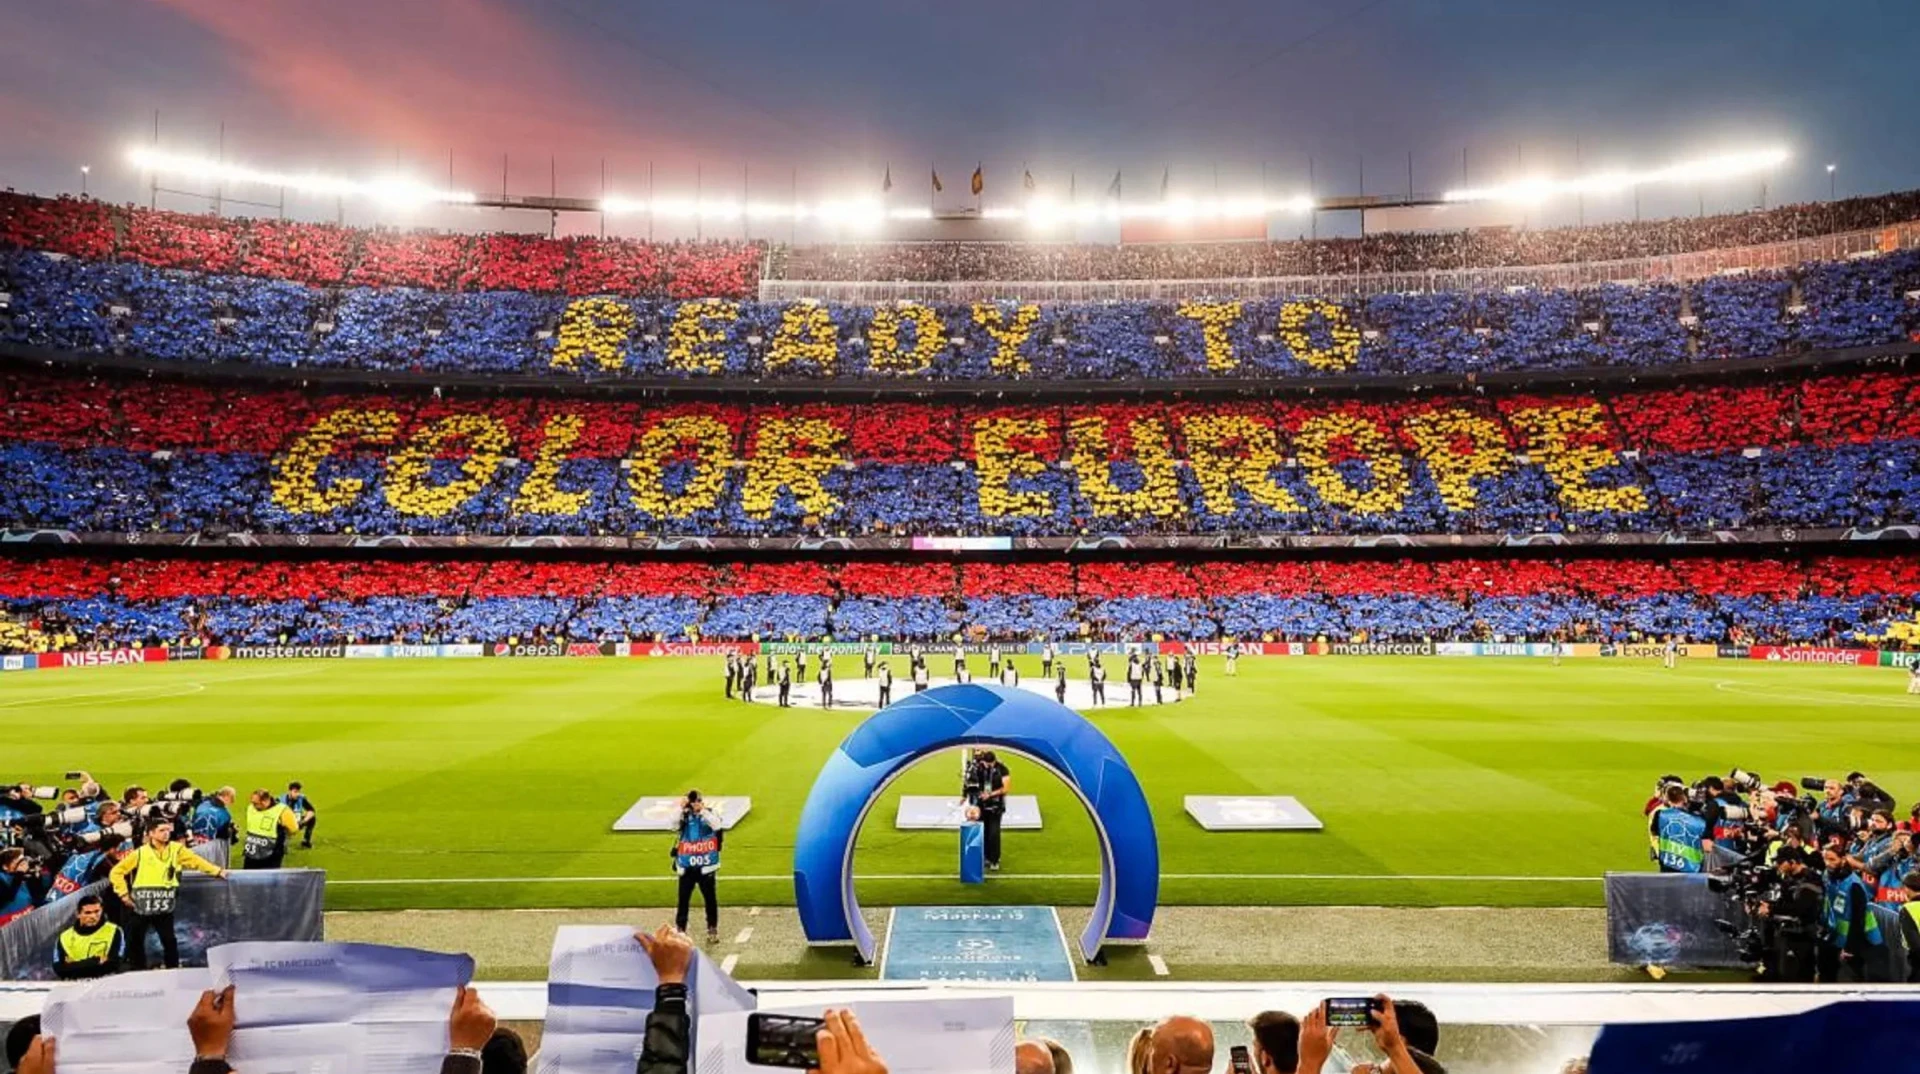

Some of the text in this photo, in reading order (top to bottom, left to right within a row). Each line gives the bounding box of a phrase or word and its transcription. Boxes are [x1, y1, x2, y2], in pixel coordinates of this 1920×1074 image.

[551, 298, 1361, 374] READY TO
[270, 404, 1648, 519] COLOR EUROPE
[236, 645, 341, 658] mastercard
[515, 644, 562, 656] pepsi
[1333, 643, 1431, 655] mastercard
[1623, 645, 1688, 657] Expea
[1781, 646, 1862, 664] Santander
[63, 650, 145, 667] NISSAN
[683, 840, 715, 853] PHOTO
[689, 855, 711, 866] 005
[136, 889, 175, 900] STEWAR
[145, 899, 169, 911] 155
